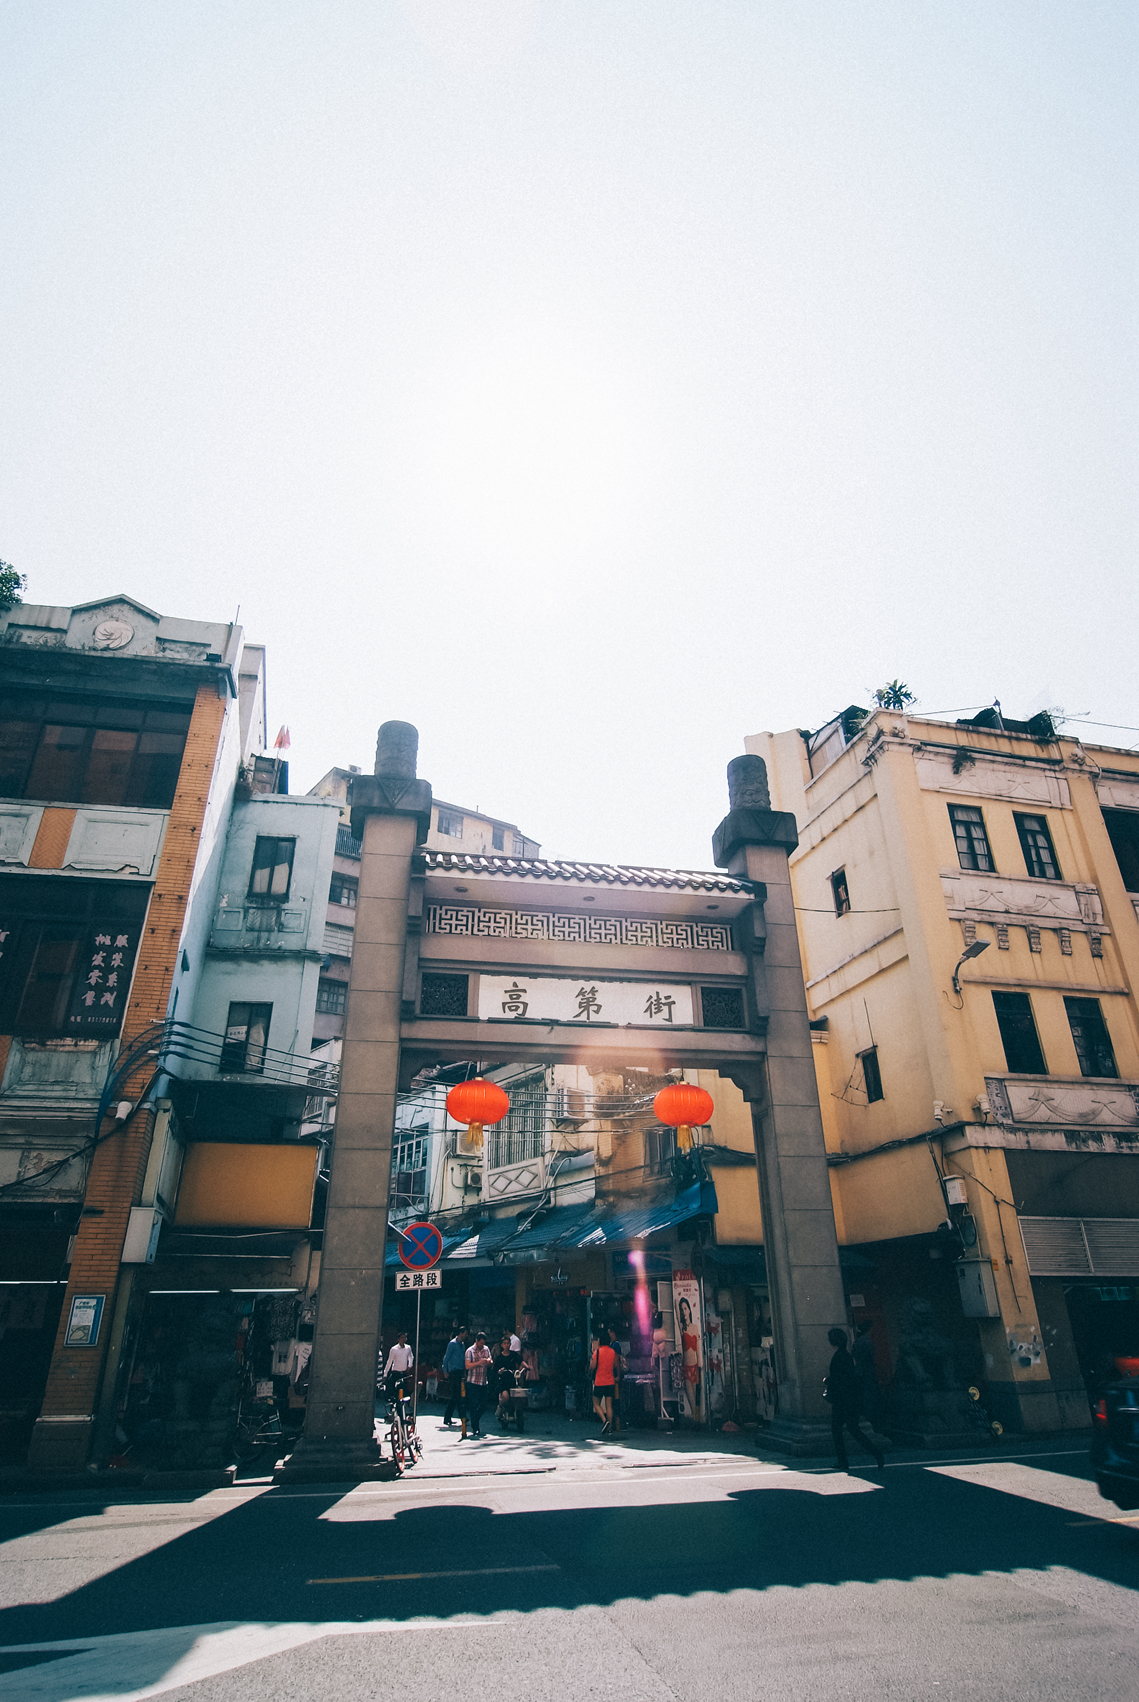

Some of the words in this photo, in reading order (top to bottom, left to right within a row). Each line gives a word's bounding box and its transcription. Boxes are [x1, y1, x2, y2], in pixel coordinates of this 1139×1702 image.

[81, 933, 112, 1007] 批发零售
[100, 934, 129, 1008] 服装系列
[501, 981, 677, 1023] 高第街
[399, 1272, 438, 1288] 全路段
